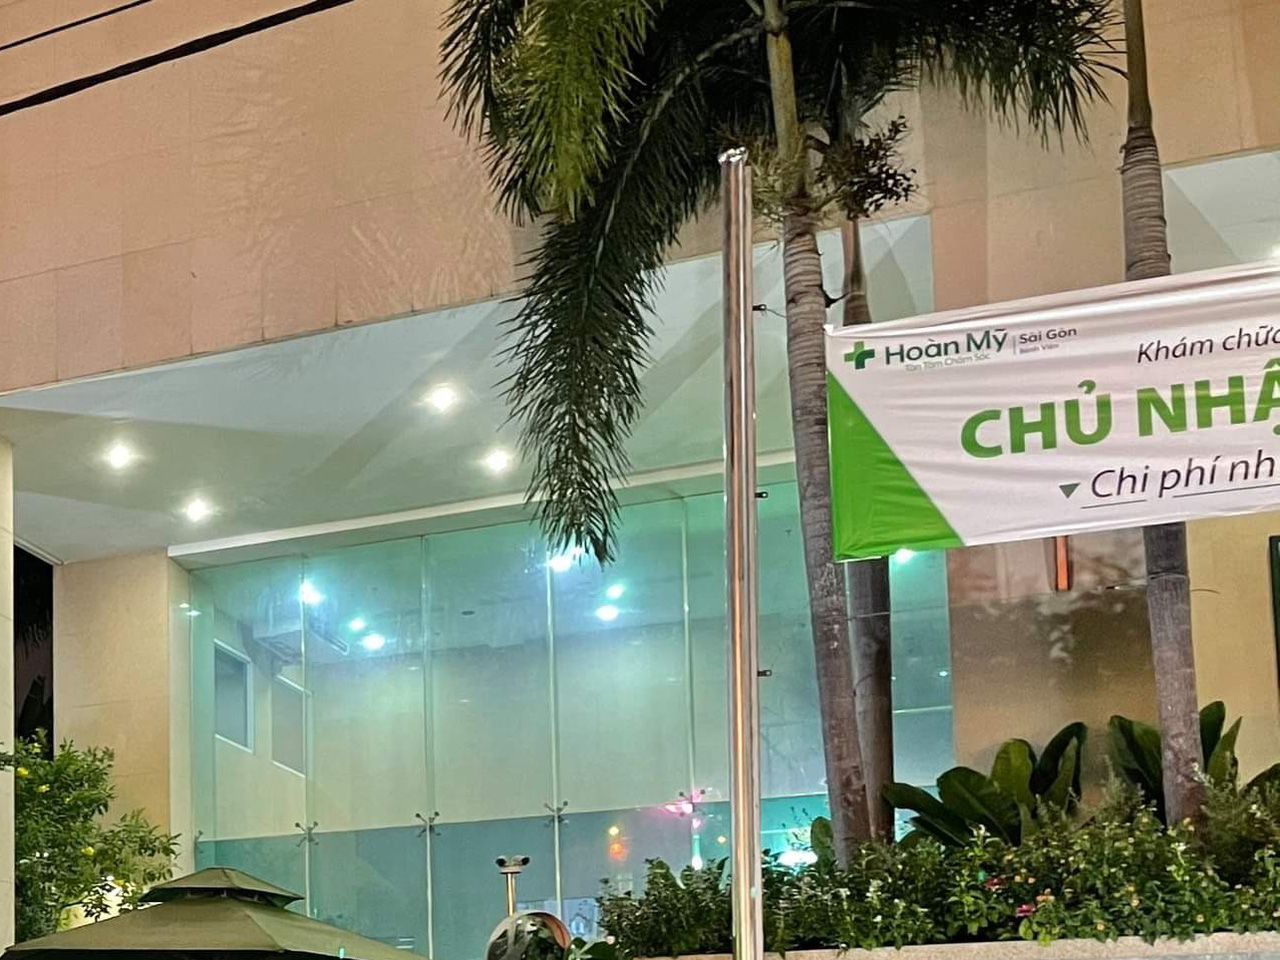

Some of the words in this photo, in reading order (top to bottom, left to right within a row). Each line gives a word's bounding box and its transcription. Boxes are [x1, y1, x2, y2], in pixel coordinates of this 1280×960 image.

[885, 338, 959, 365] Hoàn
[966, 328, 1008, 353] Mỹ
[1019, 332, 1042, 345] Sài
[1046, 327, 1078, 341] Gòn
[1137, 336, 1214, 363] Khám
[960, 379, 1113, 459] CHỦ
[1091, 465, 1150, 499] Chi
[1158, 455, 1222, 499] phí
[1228, 449, 1276, 483] nh
